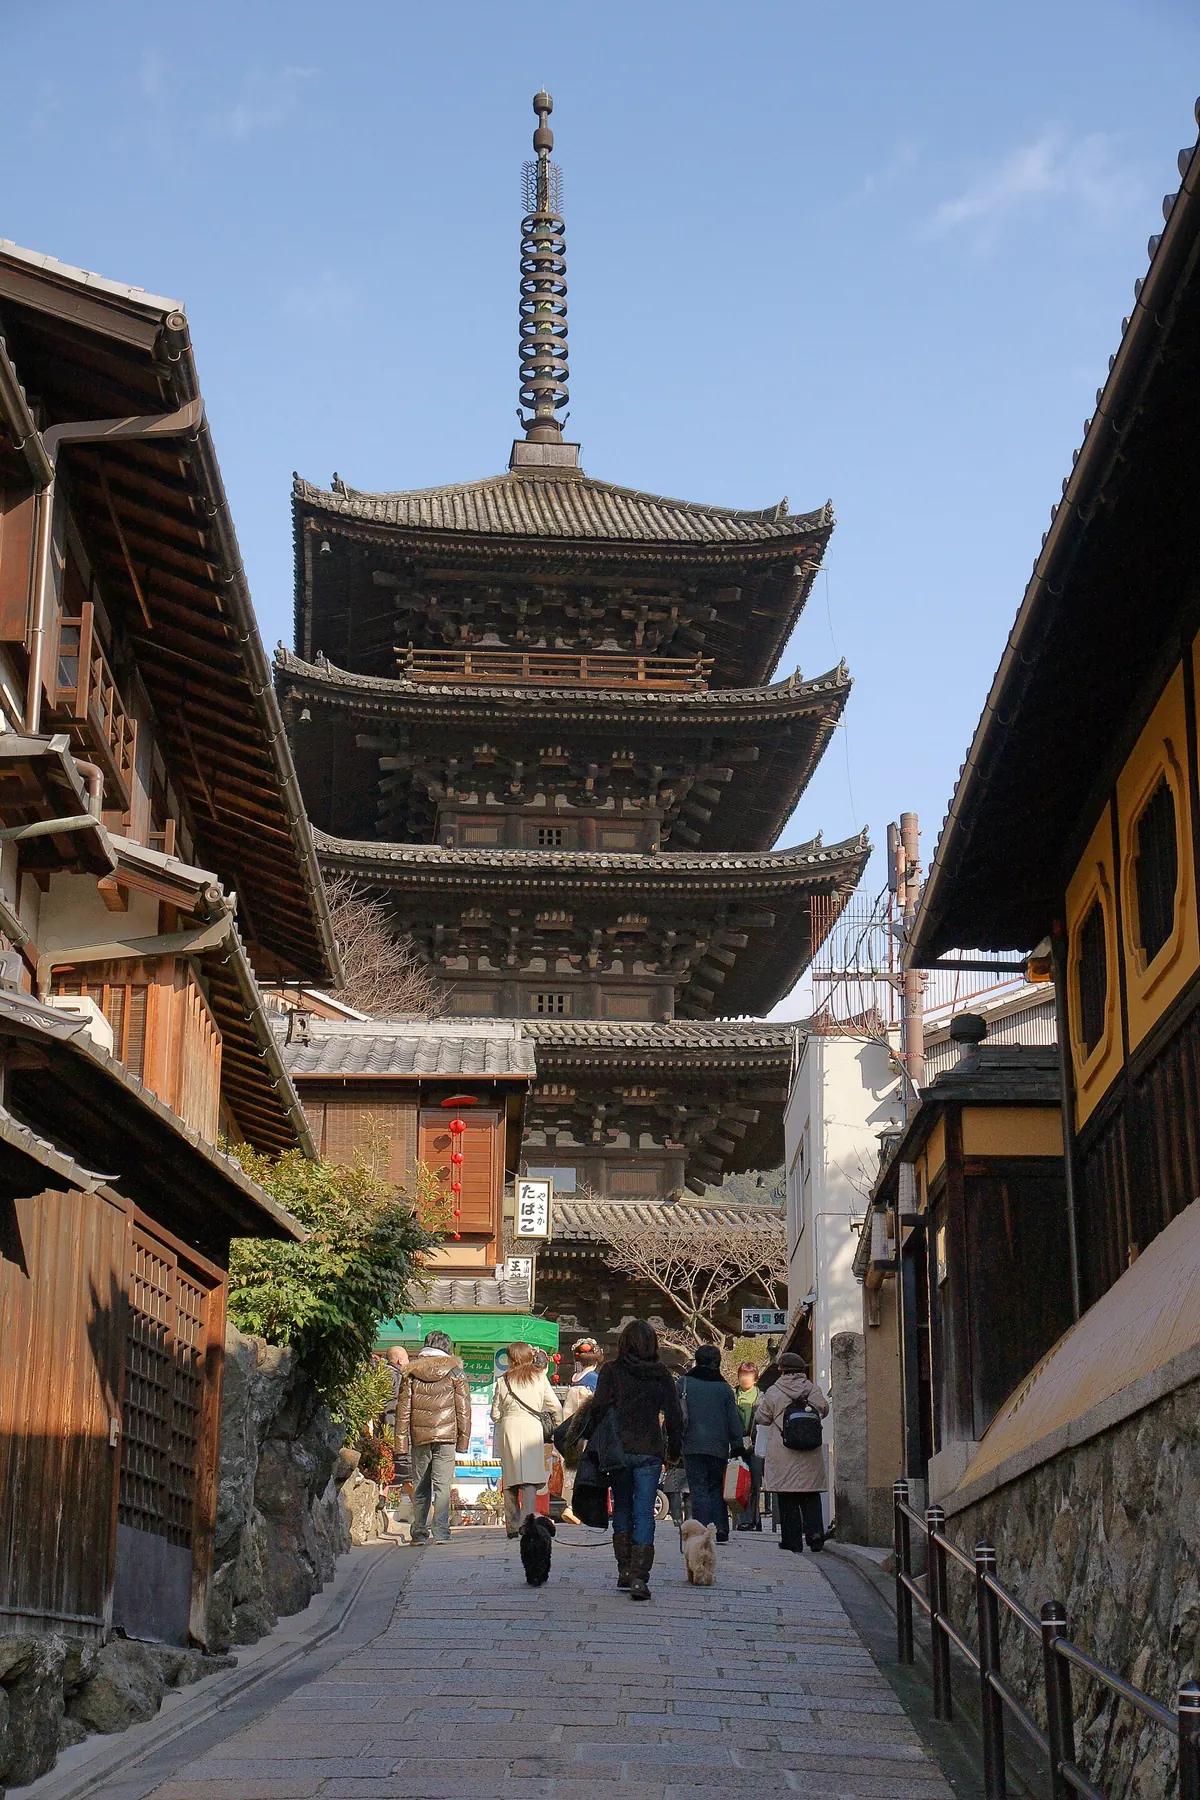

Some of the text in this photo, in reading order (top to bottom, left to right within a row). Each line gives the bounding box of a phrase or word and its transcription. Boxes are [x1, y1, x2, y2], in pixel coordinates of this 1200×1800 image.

[521, 1185, 535, 1232] たばこ
[536, 1192, 546, 1226] やさか
[464, 1362, 491, 1370] フィルム
